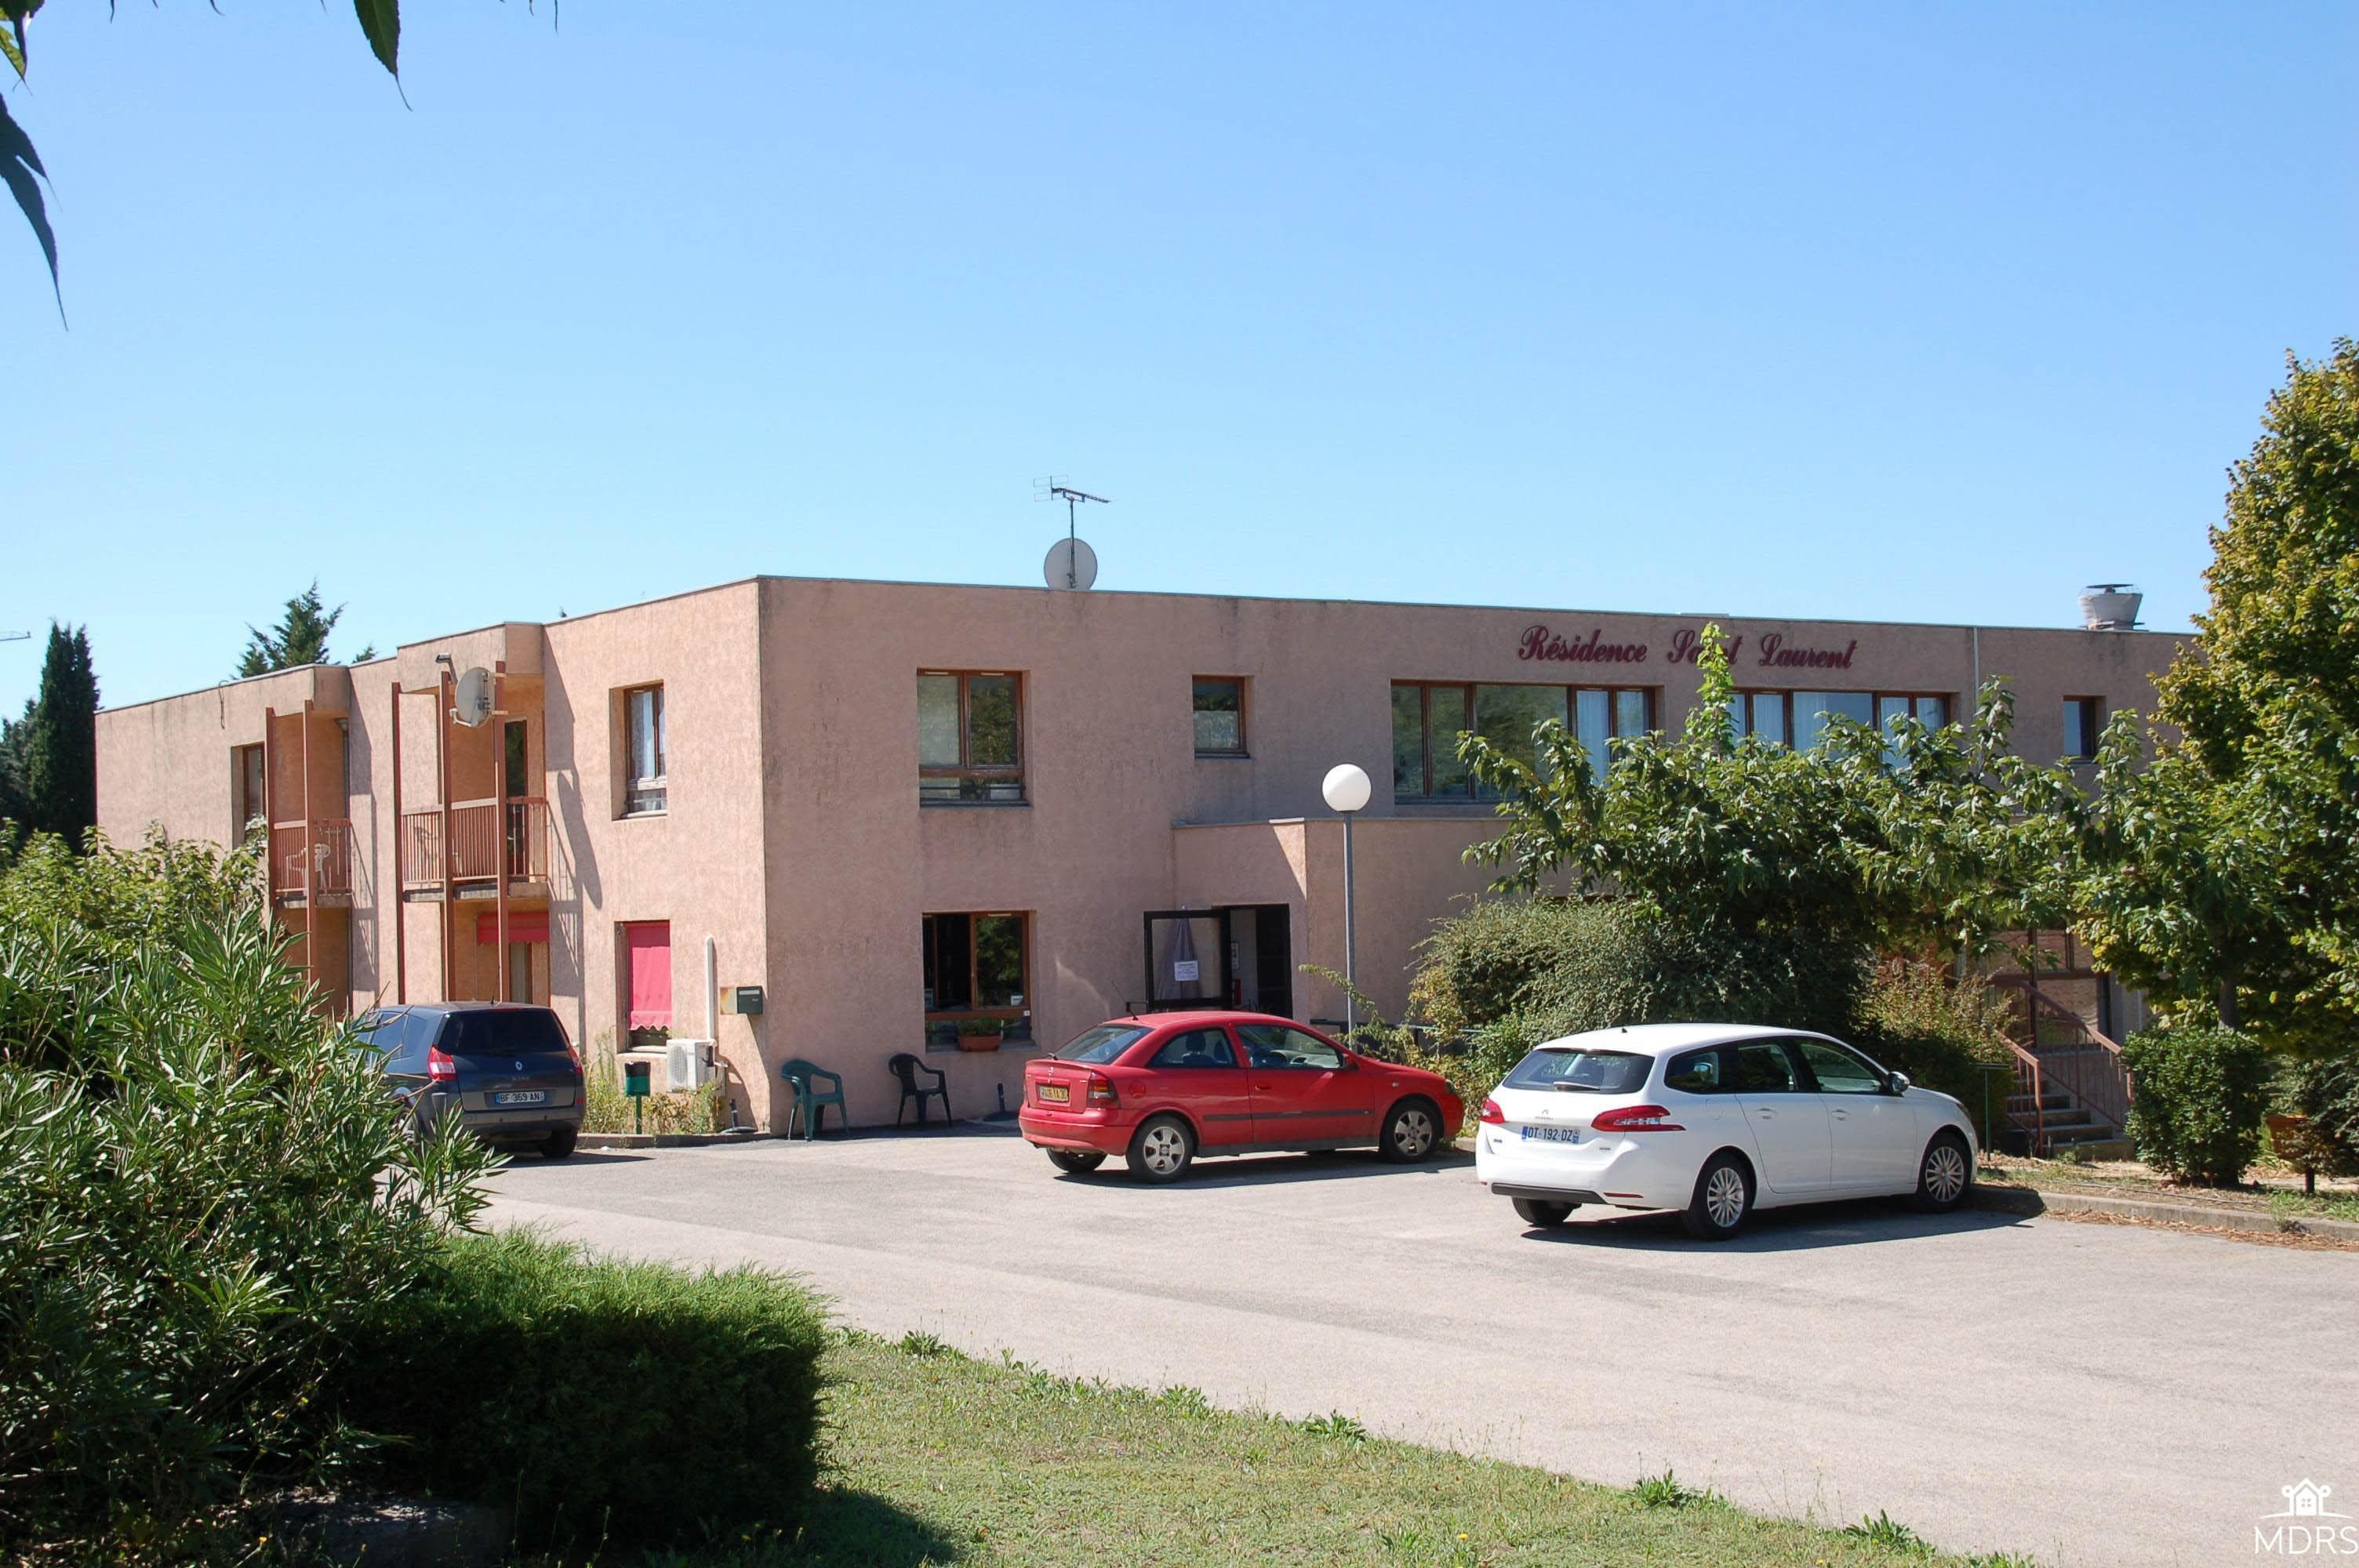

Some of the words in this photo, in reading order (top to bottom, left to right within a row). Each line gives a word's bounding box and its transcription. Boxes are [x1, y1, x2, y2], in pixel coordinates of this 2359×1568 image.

[1518, 626, 1647, 663] Résidence
[1667, 629, 1743, 665] Sat
[1759, 633, 1858, 669] Laurent
